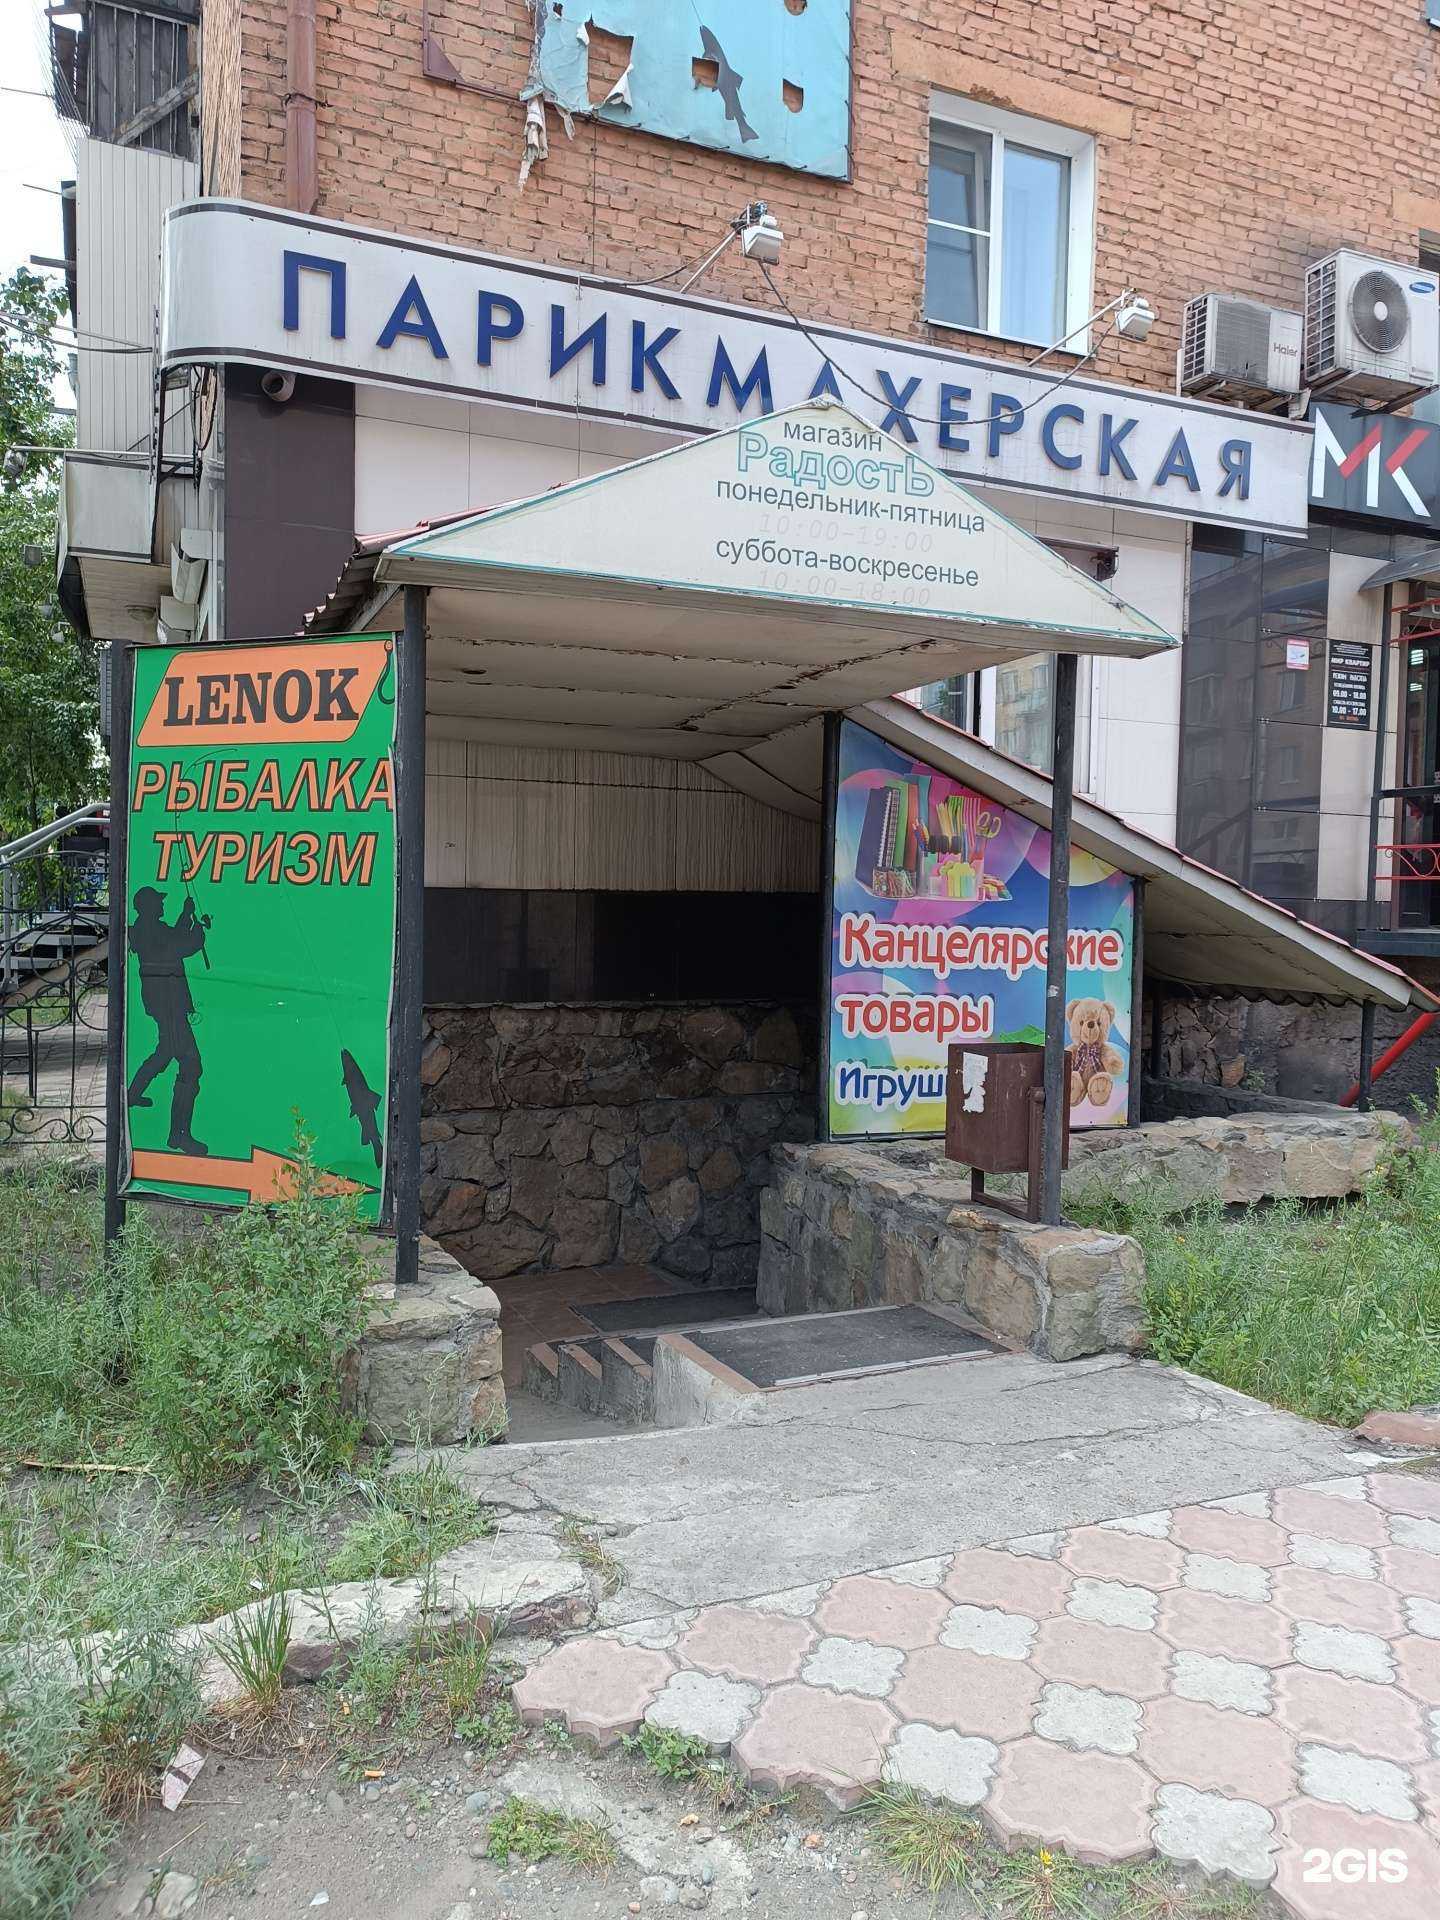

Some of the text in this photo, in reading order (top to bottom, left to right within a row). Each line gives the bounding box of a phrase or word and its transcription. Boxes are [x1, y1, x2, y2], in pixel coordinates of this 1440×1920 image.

[282, 250, 1252, 500] ПАРИКМАХЕРСКАЯ
[1273, 342, 1298, 357] Haier
[783, 421, 882, 451] магазин
[716, 479, 985, 534] понедельник-пятница
[716, 538, 979, 587] суббота-воскресенье
[163, 668, 359, 726] LENOK
[132, 757, 394, 812] РЫБАЛКА
[153, 830, 379, 886] ТУРИЗМ
[841, 999, 989, 1043] товары
[840, 1067, 947, 1106] Игруш
